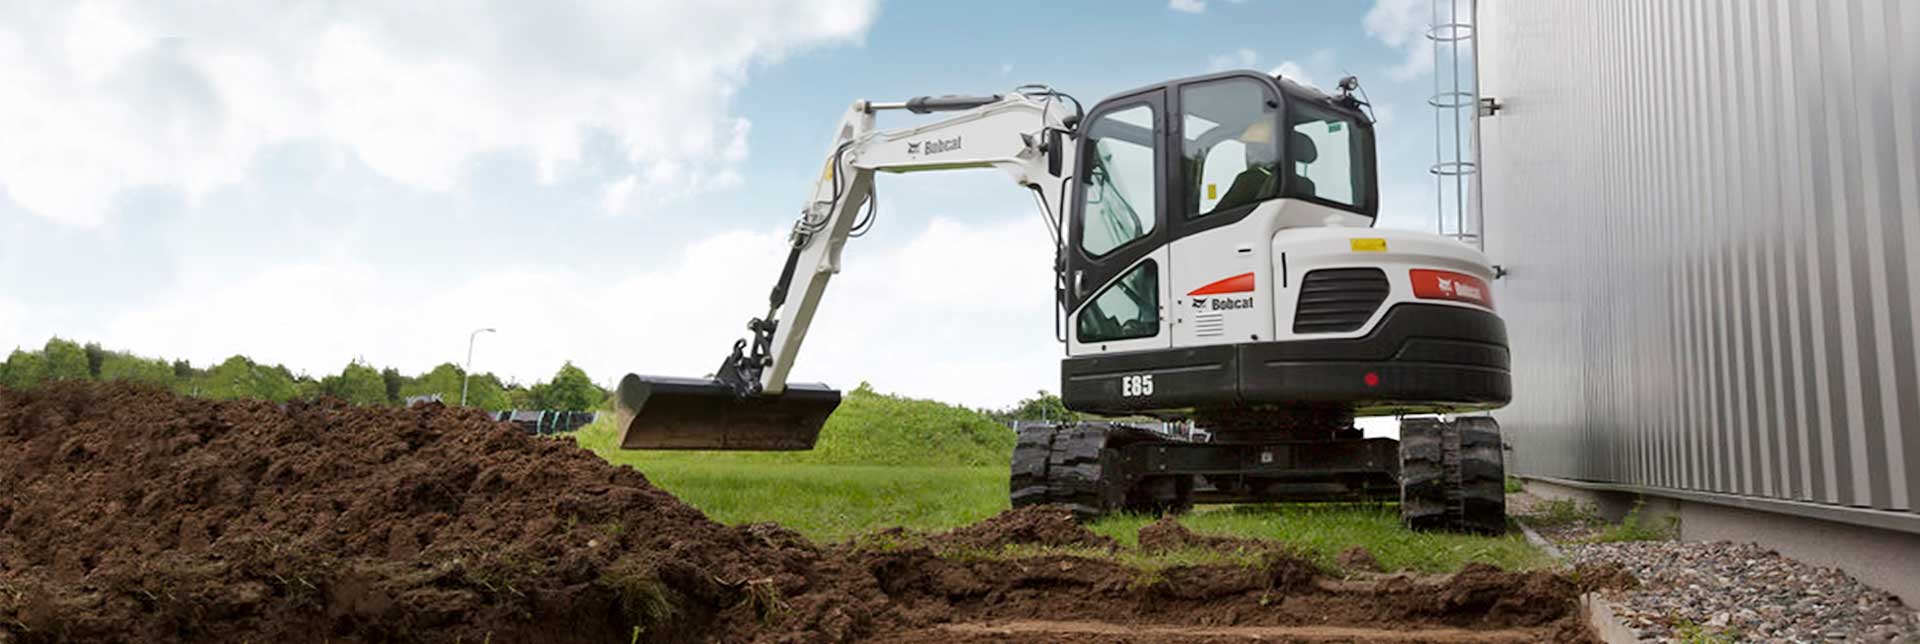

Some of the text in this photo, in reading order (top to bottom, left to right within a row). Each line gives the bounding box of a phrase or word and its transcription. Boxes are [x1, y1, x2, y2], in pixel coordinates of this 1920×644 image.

[925, 136, 962, 155] Bobcat
[1212, 297, 1254, 311] Bobcat
[1122, 374, 1154, 397] E85
